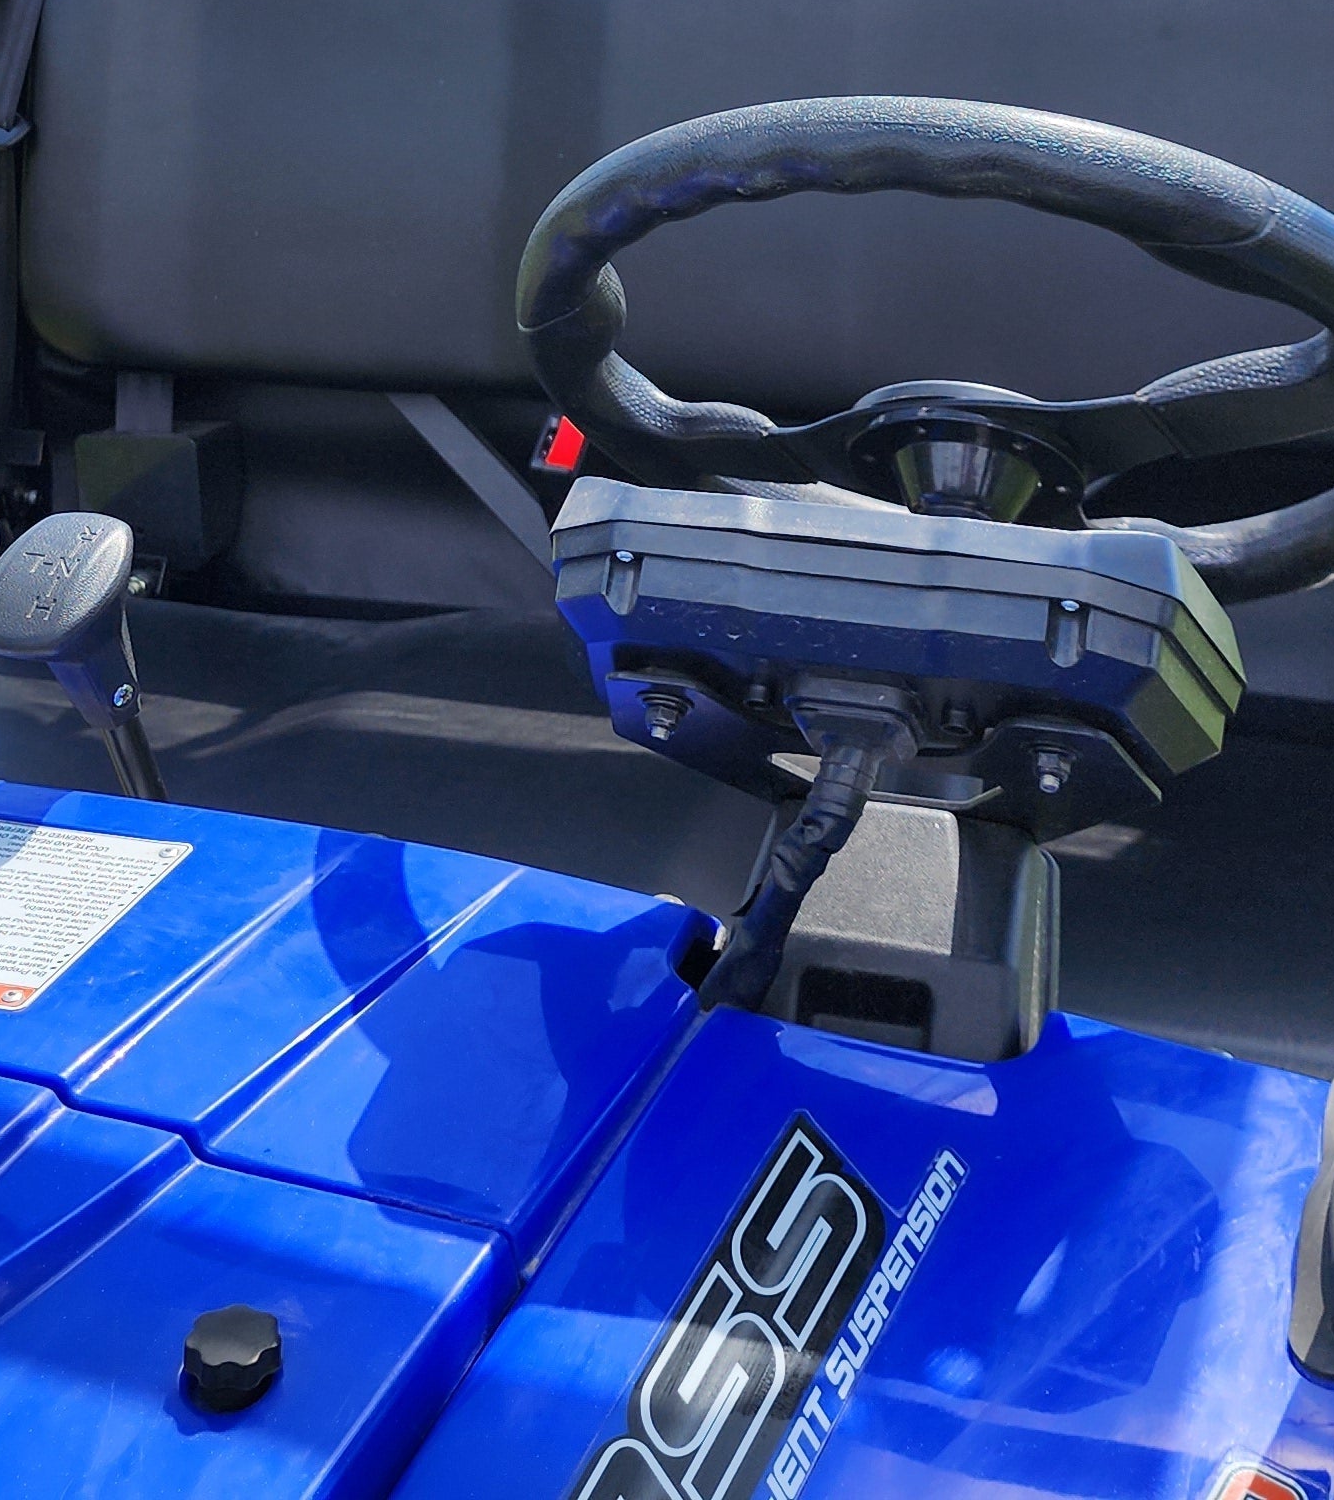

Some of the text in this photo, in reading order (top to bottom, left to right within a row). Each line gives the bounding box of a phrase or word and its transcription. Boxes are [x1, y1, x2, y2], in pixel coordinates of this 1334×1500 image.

[7, 833, 30, 841] THE
[25, 836, 55, 845] READ
[45, 831, 97, 843] RESERVED
[51, 839, 75, 847] AND
[72, 842, 111, 852] LOCATE
[18, 902, 109, 920] Drive Responsibly
[29, 969, 48, 977] Be
[825, 1150, 966, 1400] SUSPENSION
[572, 1128, 867, 1500] SS
